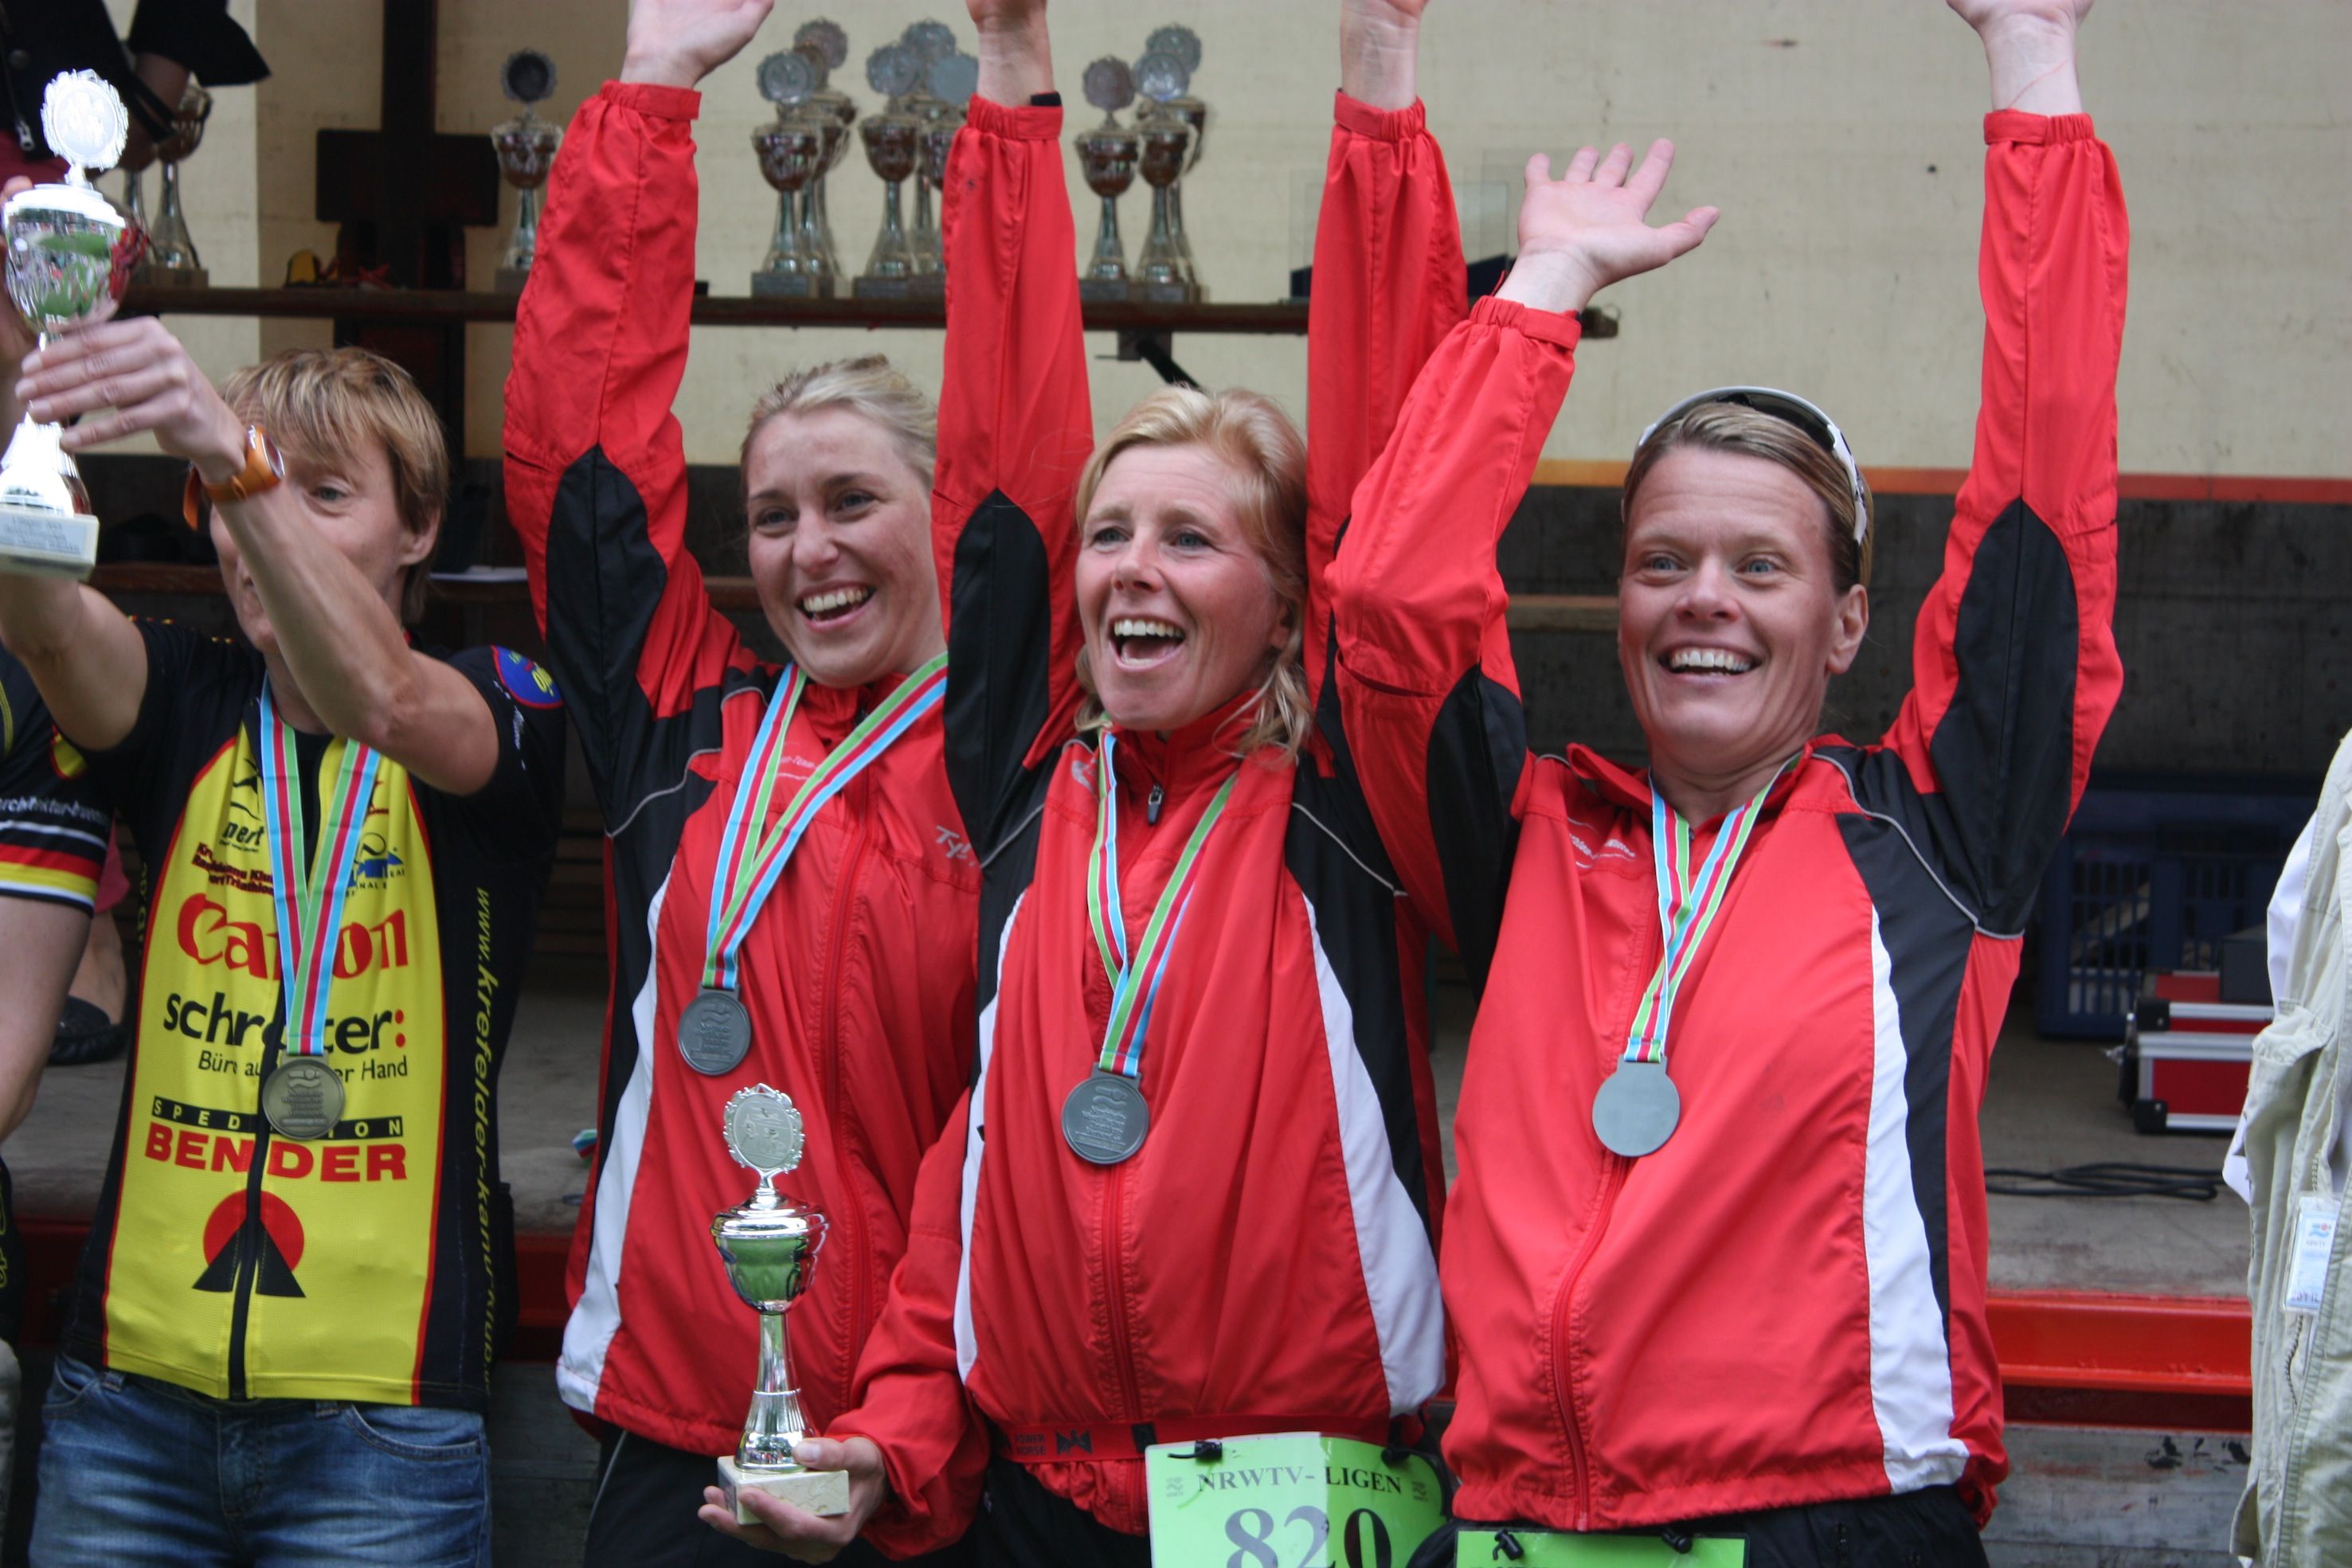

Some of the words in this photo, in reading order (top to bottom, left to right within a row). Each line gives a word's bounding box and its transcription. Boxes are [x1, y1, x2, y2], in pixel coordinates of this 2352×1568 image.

[178, 893, 409, 980] Caon
[361, 1054, 408, 1081] Hand
[153, 1099, 401, 1139] SPEDION
[145, 1120, 408, 1182] BENDER
[1325, 1466, 1402, 1495] LIGEN
[1224, 1505, 1392, 1568] 820
